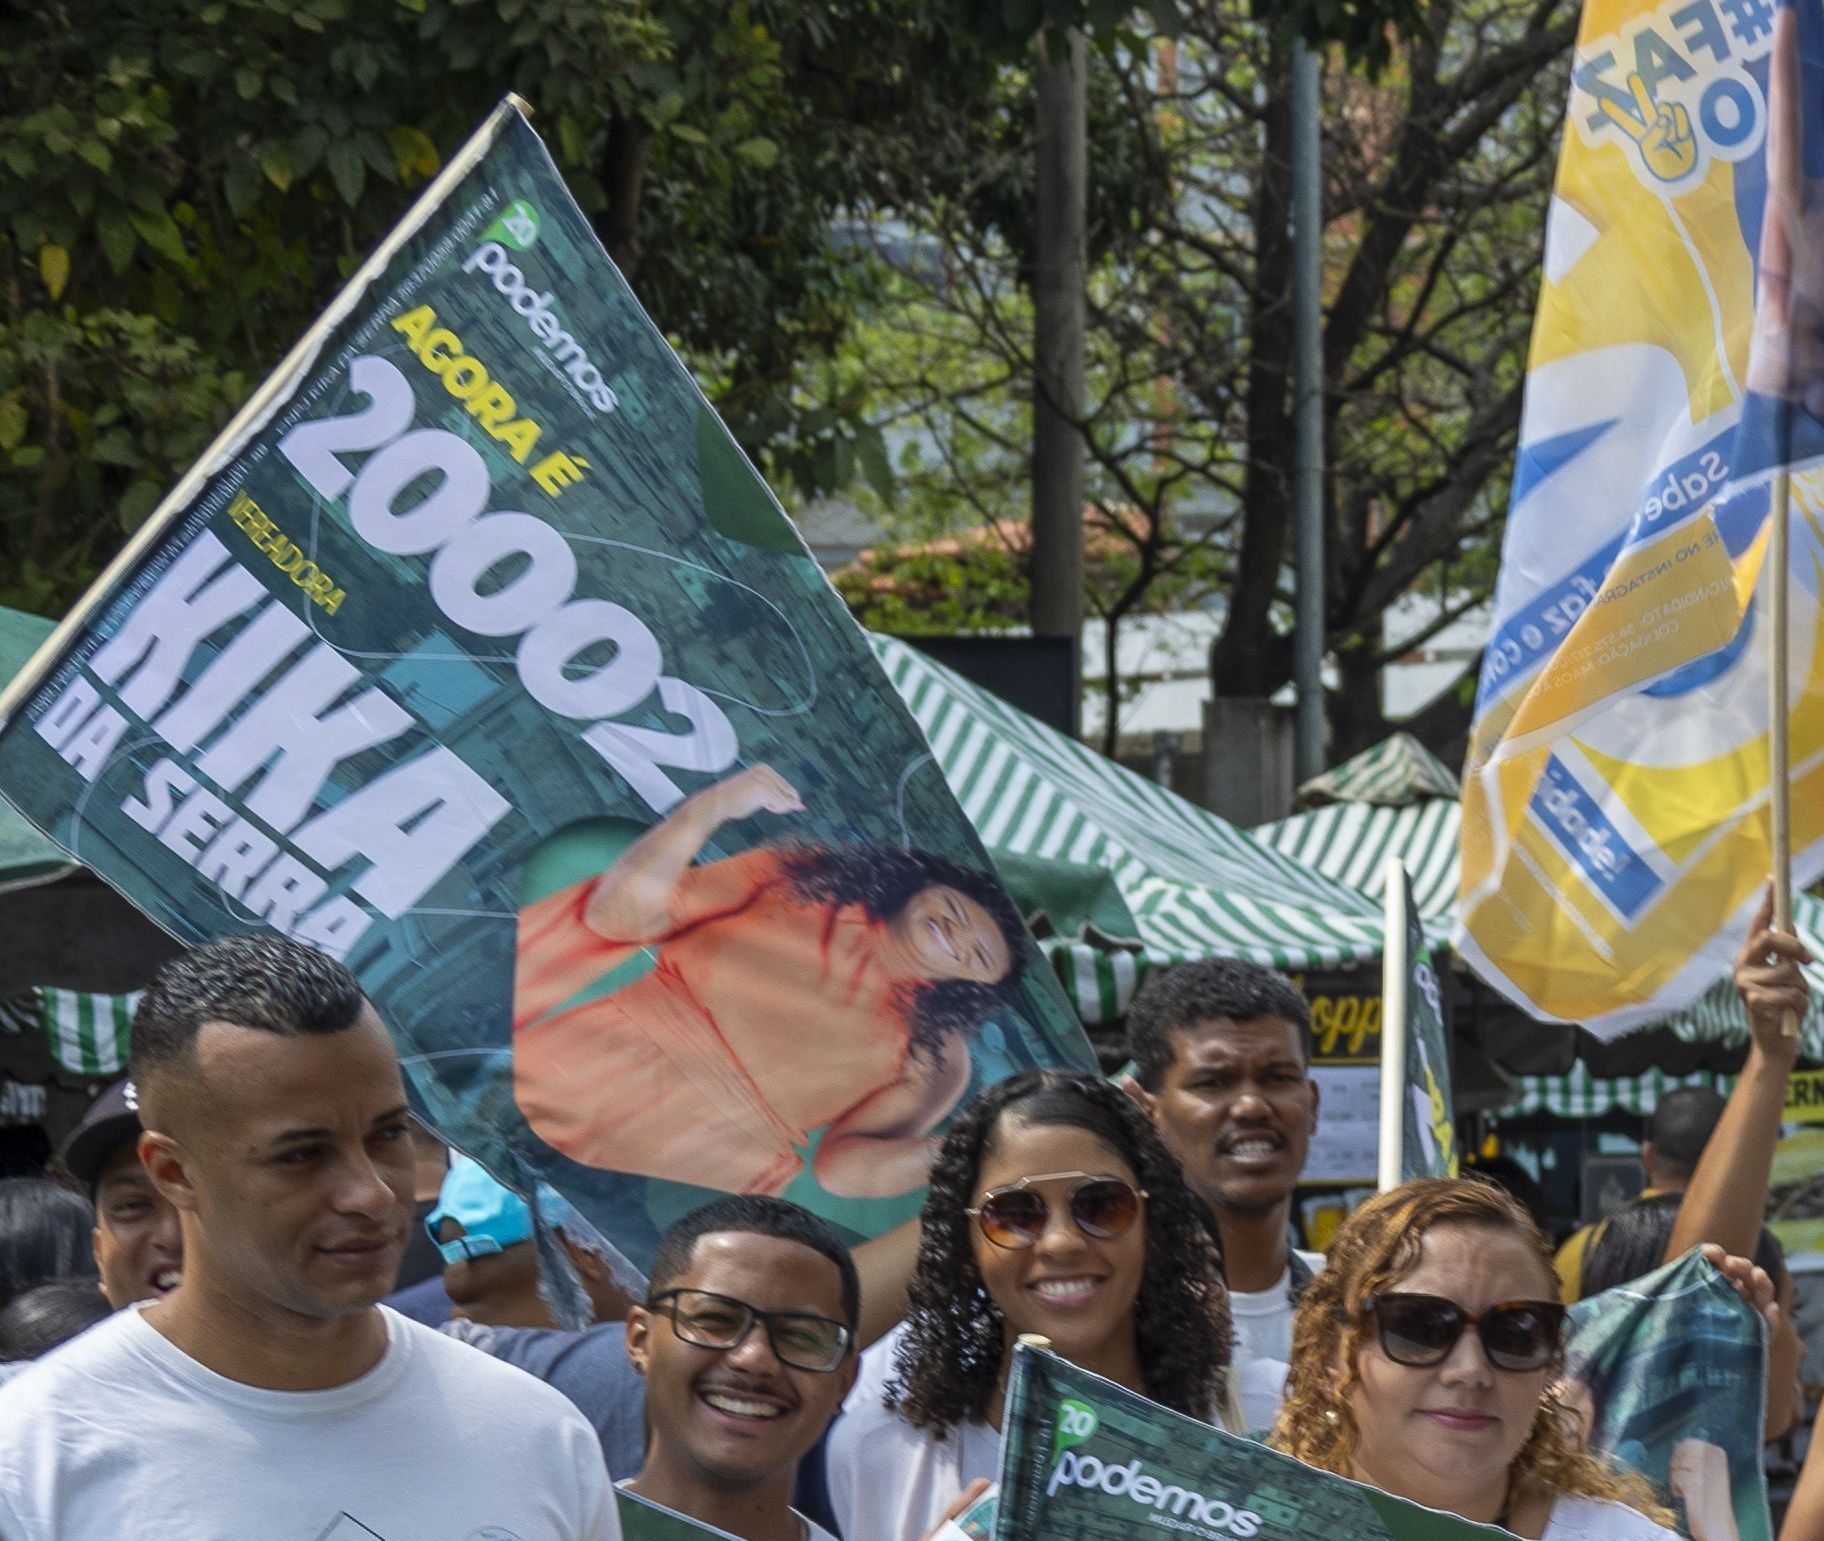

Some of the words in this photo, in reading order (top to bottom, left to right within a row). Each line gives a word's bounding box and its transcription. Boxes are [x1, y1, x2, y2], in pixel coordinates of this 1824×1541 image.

[502, 203, 537, 248] 20
[391, 305, 543, 465] AGORA
[529, 450, 593, 498] É
[462, 241, 619, 413] podemos
[227, 489, 346, 617] VEREADORA
[278, 355, 740, 812] 20002
[33, 673, 131, 782] DA
[87, 527, 512, 920] KIKA
[121, 754, 373, 963] SERRA
[1046, 1450, 1264, 1540] podemos
[1059, 1403, 1095, 1438] 20
